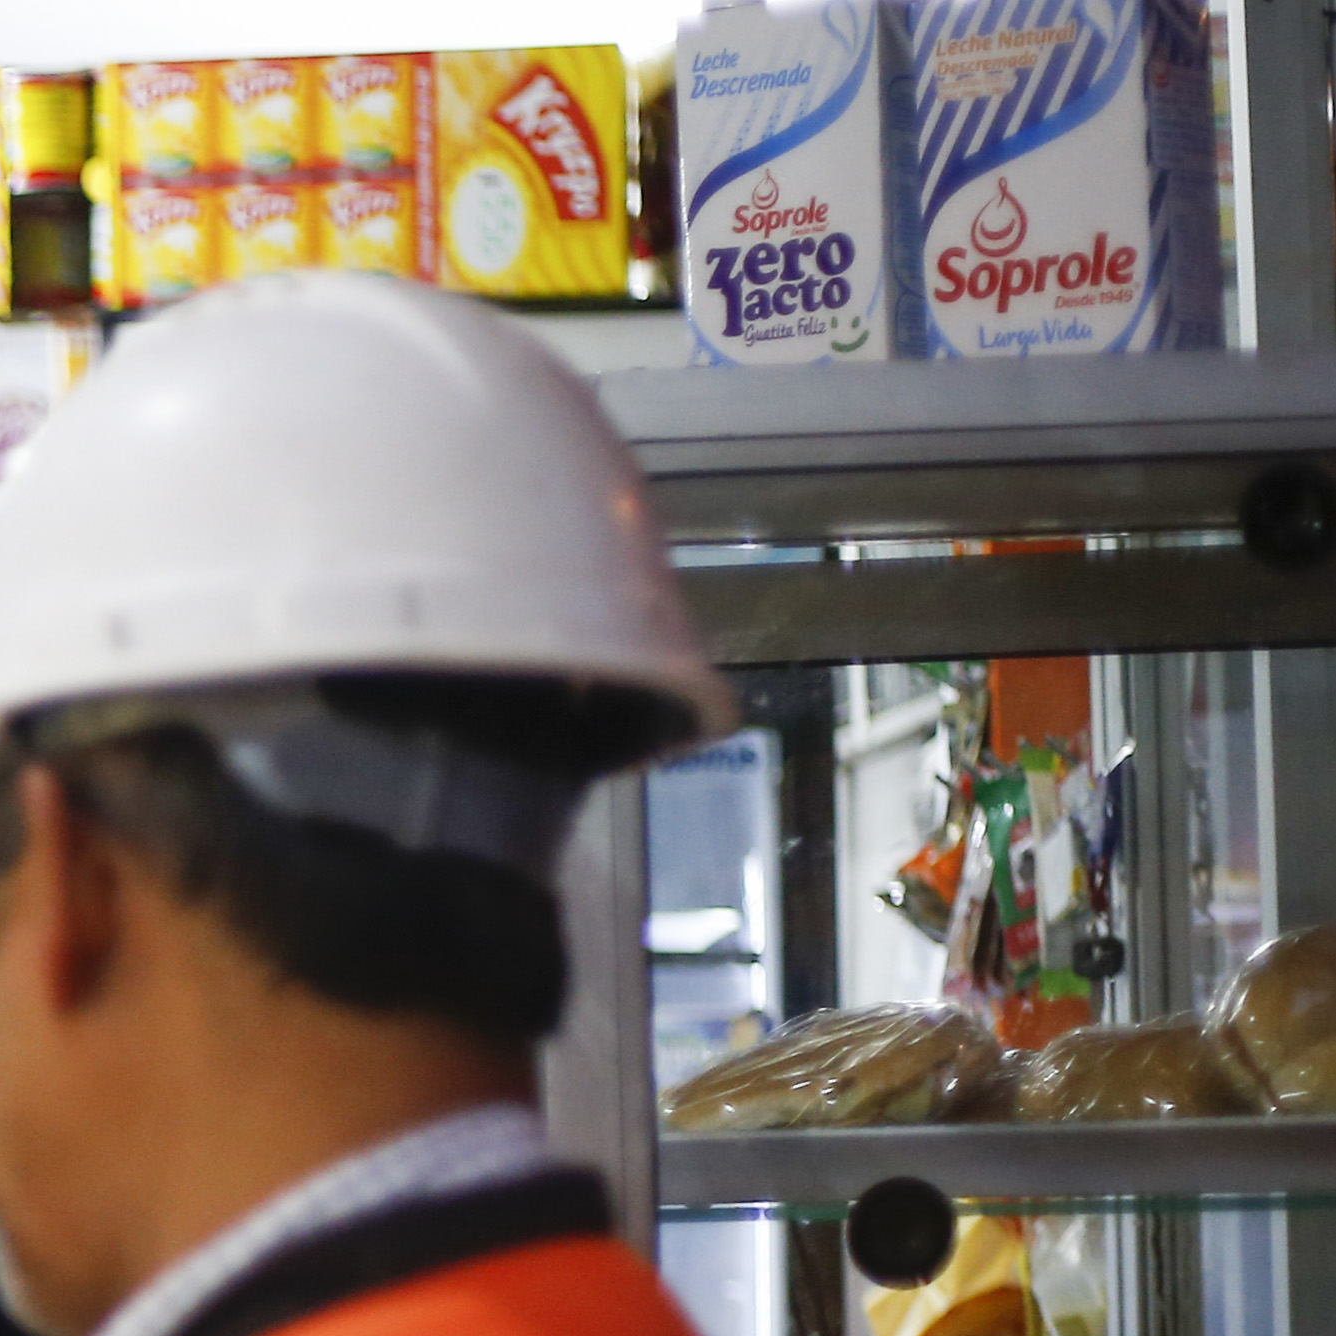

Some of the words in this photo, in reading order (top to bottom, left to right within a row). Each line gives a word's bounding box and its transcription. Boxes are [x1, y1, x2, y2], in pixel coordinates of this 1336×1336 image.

[936, 34, 992, 57] Leche
[998, 21, 1076, 48] Natural
[691, 62, 813, 99] Descremada
[693, 49, 739, 73] Leche
[732, 195, 829, 239] Soprole
[706, 232, 856, 290] zero
[934, 231, 1138, 314] Soprole
[722, 272, 852, 337] lacto
[1043, 317, 1094, 345] Vida
